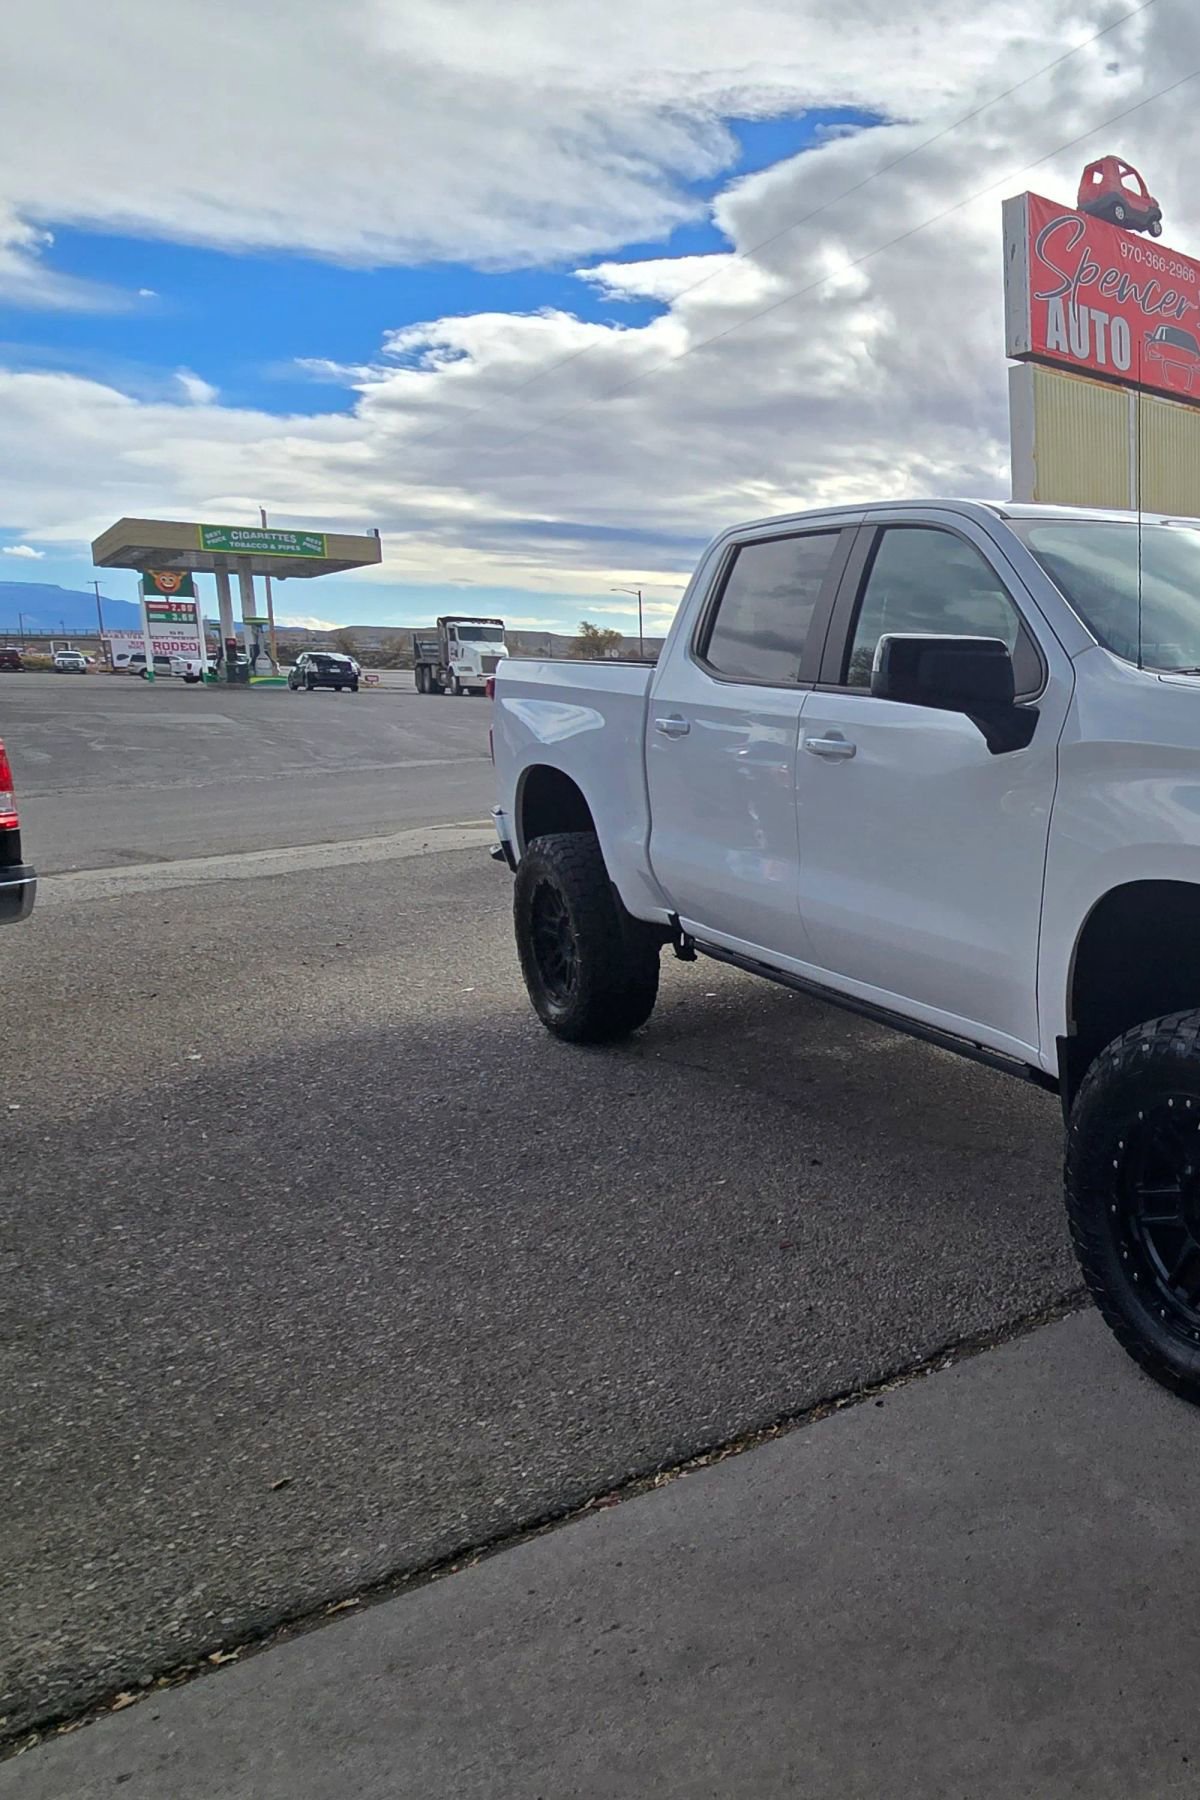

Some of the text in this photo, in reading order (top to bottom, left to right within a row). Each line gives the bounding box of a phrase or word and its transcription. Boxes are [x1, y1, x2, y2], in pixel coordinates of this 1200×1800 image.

[1120, 242, 1196, 284] 970-366-2966
[1046, 297, 1132, 372] AUTO
[231, 530, 297, 544] CIGARETTES
[229, 541, 268, 550] TOBACCO
[152, 641, 198, 652] RODEO
